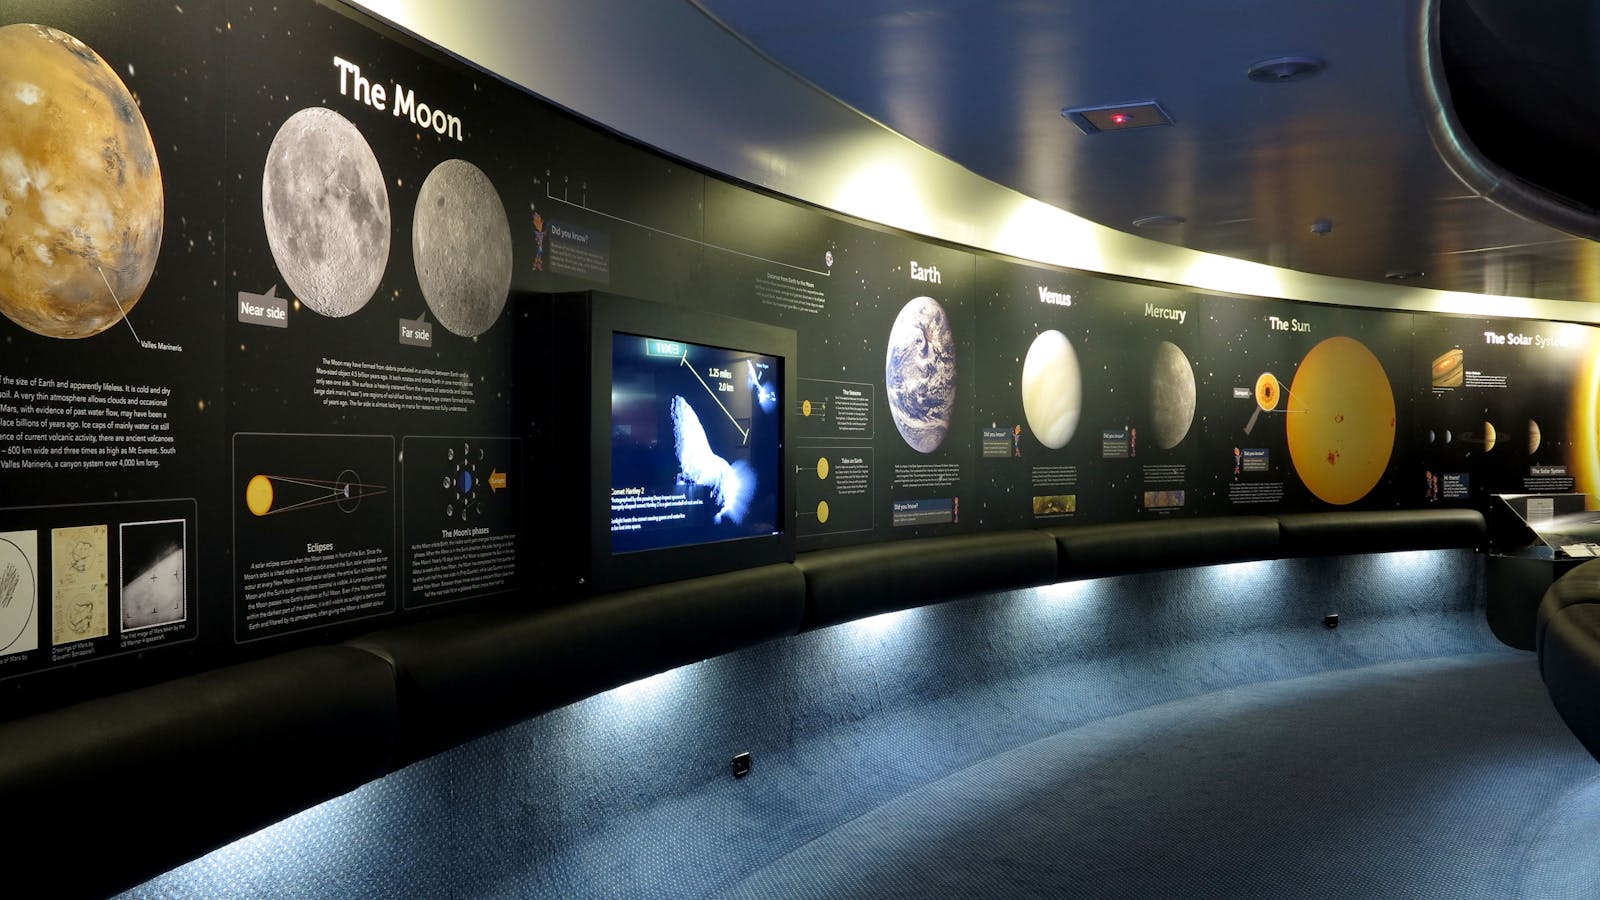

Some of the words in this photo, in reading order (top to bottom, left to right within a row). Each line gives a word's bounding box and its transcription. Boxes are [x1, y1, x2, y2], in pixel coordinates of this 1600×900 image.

[334, 56, 386, 110] The
[394, 85, 462, 141] Moon
[552, 225, 560, 235] Did
[572, 232, 588, 242] know?
[910, 261, 941, 284] Earth
[1038, 286, 1071, 307] Venus
[241, 301, 263, 317] Near
[266, 305, 285, 320] side
[1145, 303, 1186, 324] Mercury
[1269, 316, 1288, 331] The
[1292, 319, 1310, 332] Sun
[402, 326, 413, 338] Far
[414, 328, 429, 340] side
[1484, 332, 1505, 344] The
[1507, 333, 1533, 345] Solar
[141, 340, 157, 349] Valles
[158, 342, 182, 352] Marineris
[720, 370, 732, 379] miles
[727, 383, 734, 392] km
[0, 404, 18, 415] Mars,
[8, 445, 20, 455] 600
[625, 487, 641, 497] Hartley
[442, 530, 452, 538] The
[453, 529, 471, 537] Moon's
[472, 528, 489, 536] phases
[307, 542, 333, 553] Eclipses
